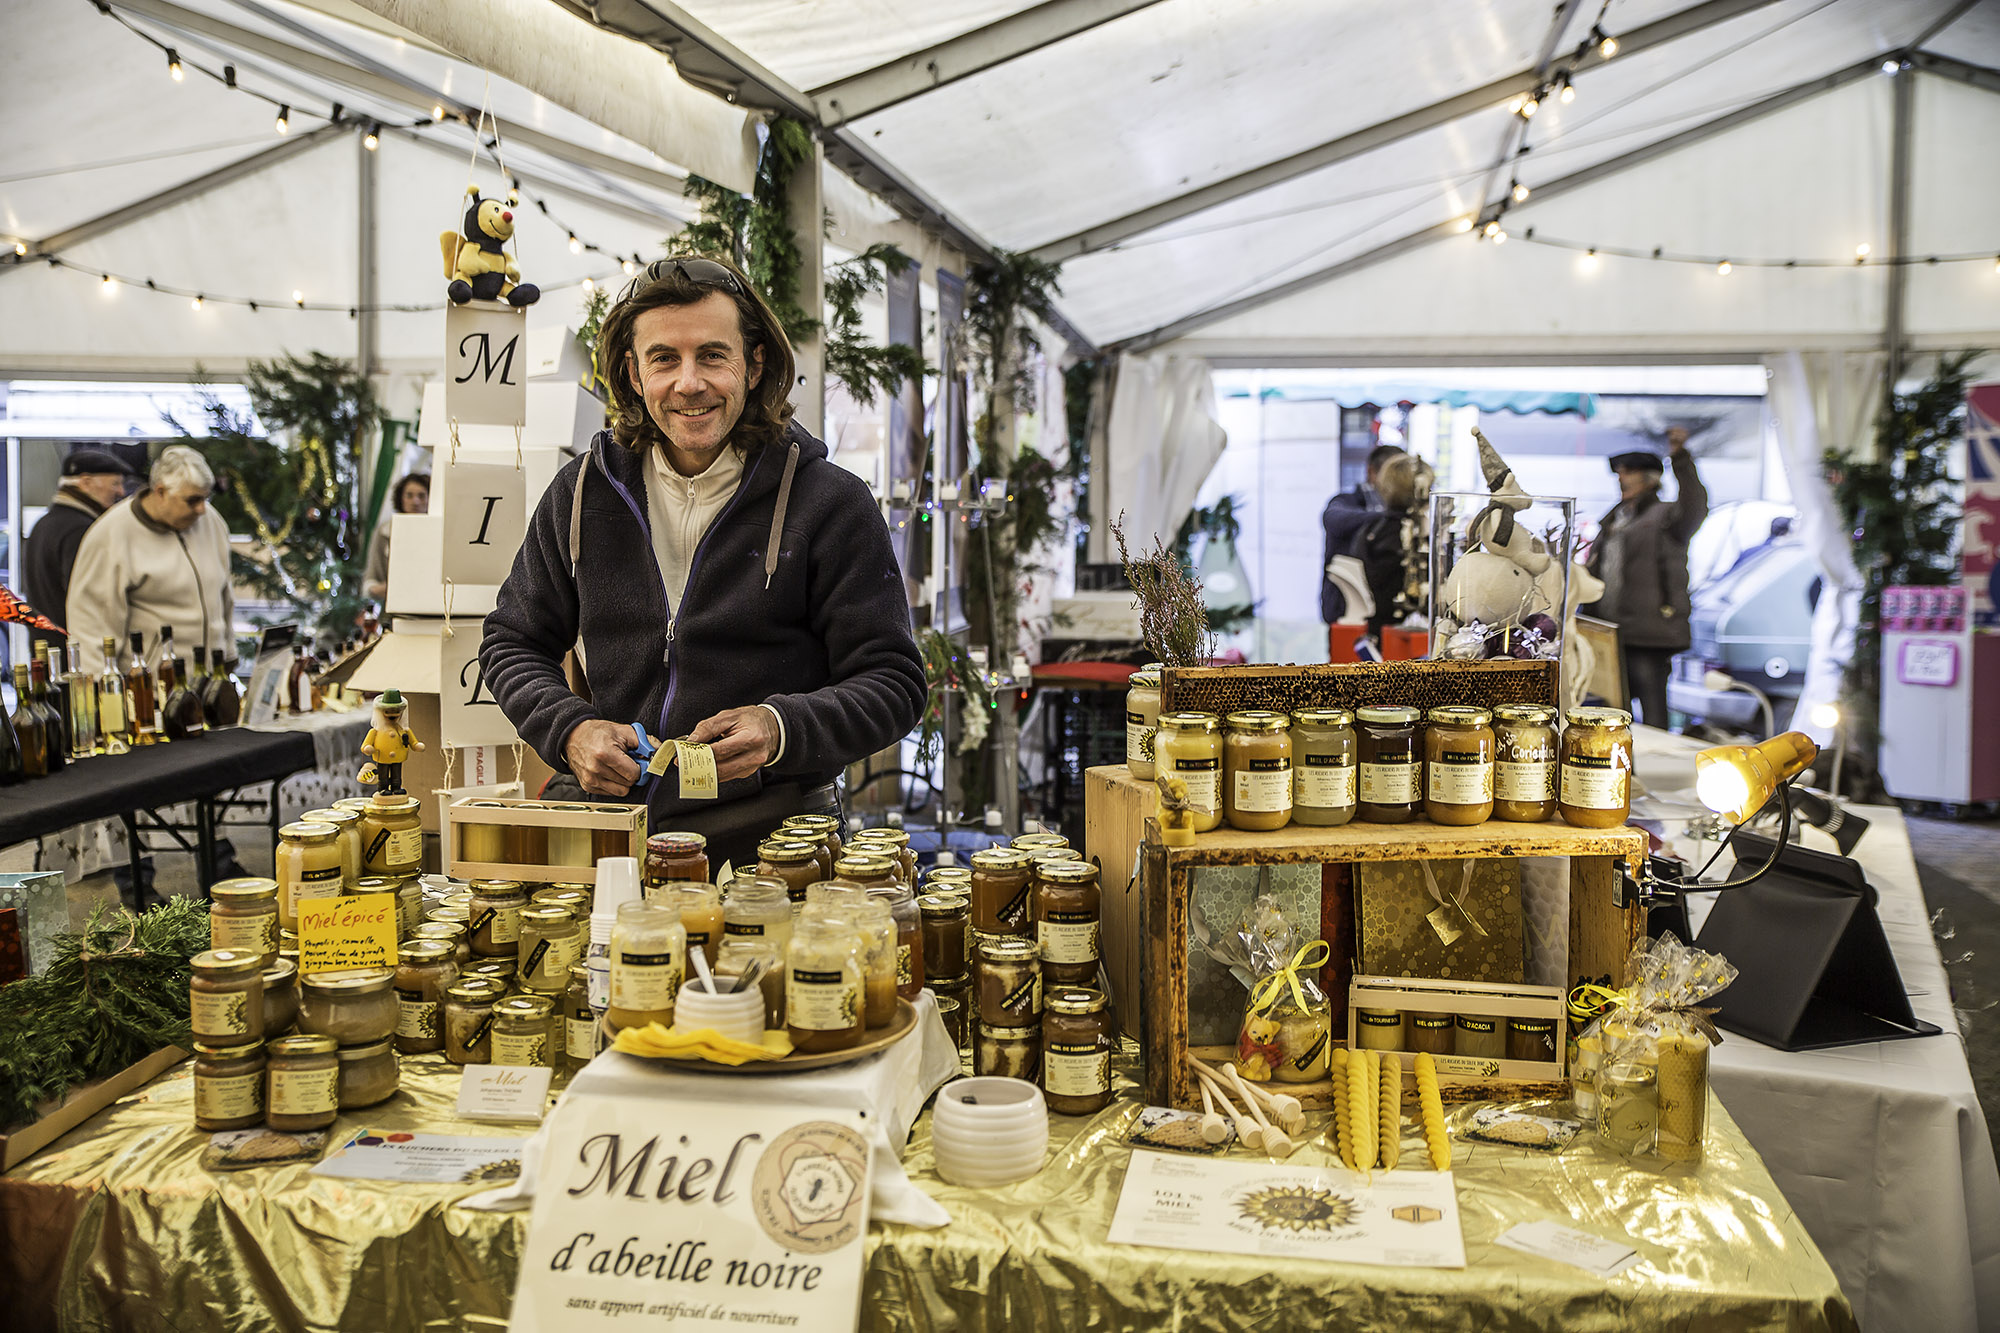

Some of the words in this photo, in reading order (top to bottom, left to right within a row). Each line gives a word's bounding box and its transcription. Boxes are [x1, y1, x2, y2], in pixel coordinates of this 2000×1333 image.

[455, 333, 520, 386] M
[468, 496, 503, 546] I
[476, 746, 485, 787] FRAGILE
[1512, 745, 1555, 760] Coriandre
[303, 912, 337, 931] Miel
[341, 907, 389, 928] épicé
[1467, 1022, 1490, 1030] D'ACACIA
[480, 1070, 528, 1086] Miel
[568, 1134, 760, 1203] Miel
[1155, 1200, 1194, 1210] MIEL
[550, 1233, 713, 1283] d'abeille
[726, 1252, 823, 1291] noire
[567, 1298, 596, 1310] sans
[600, 1301, 645, 1317] apport
[649, 1302, 708, 1322] artificiel
[710, 1304, 725, 1321] de
[730, 1310, 799, 1326] nourriture
